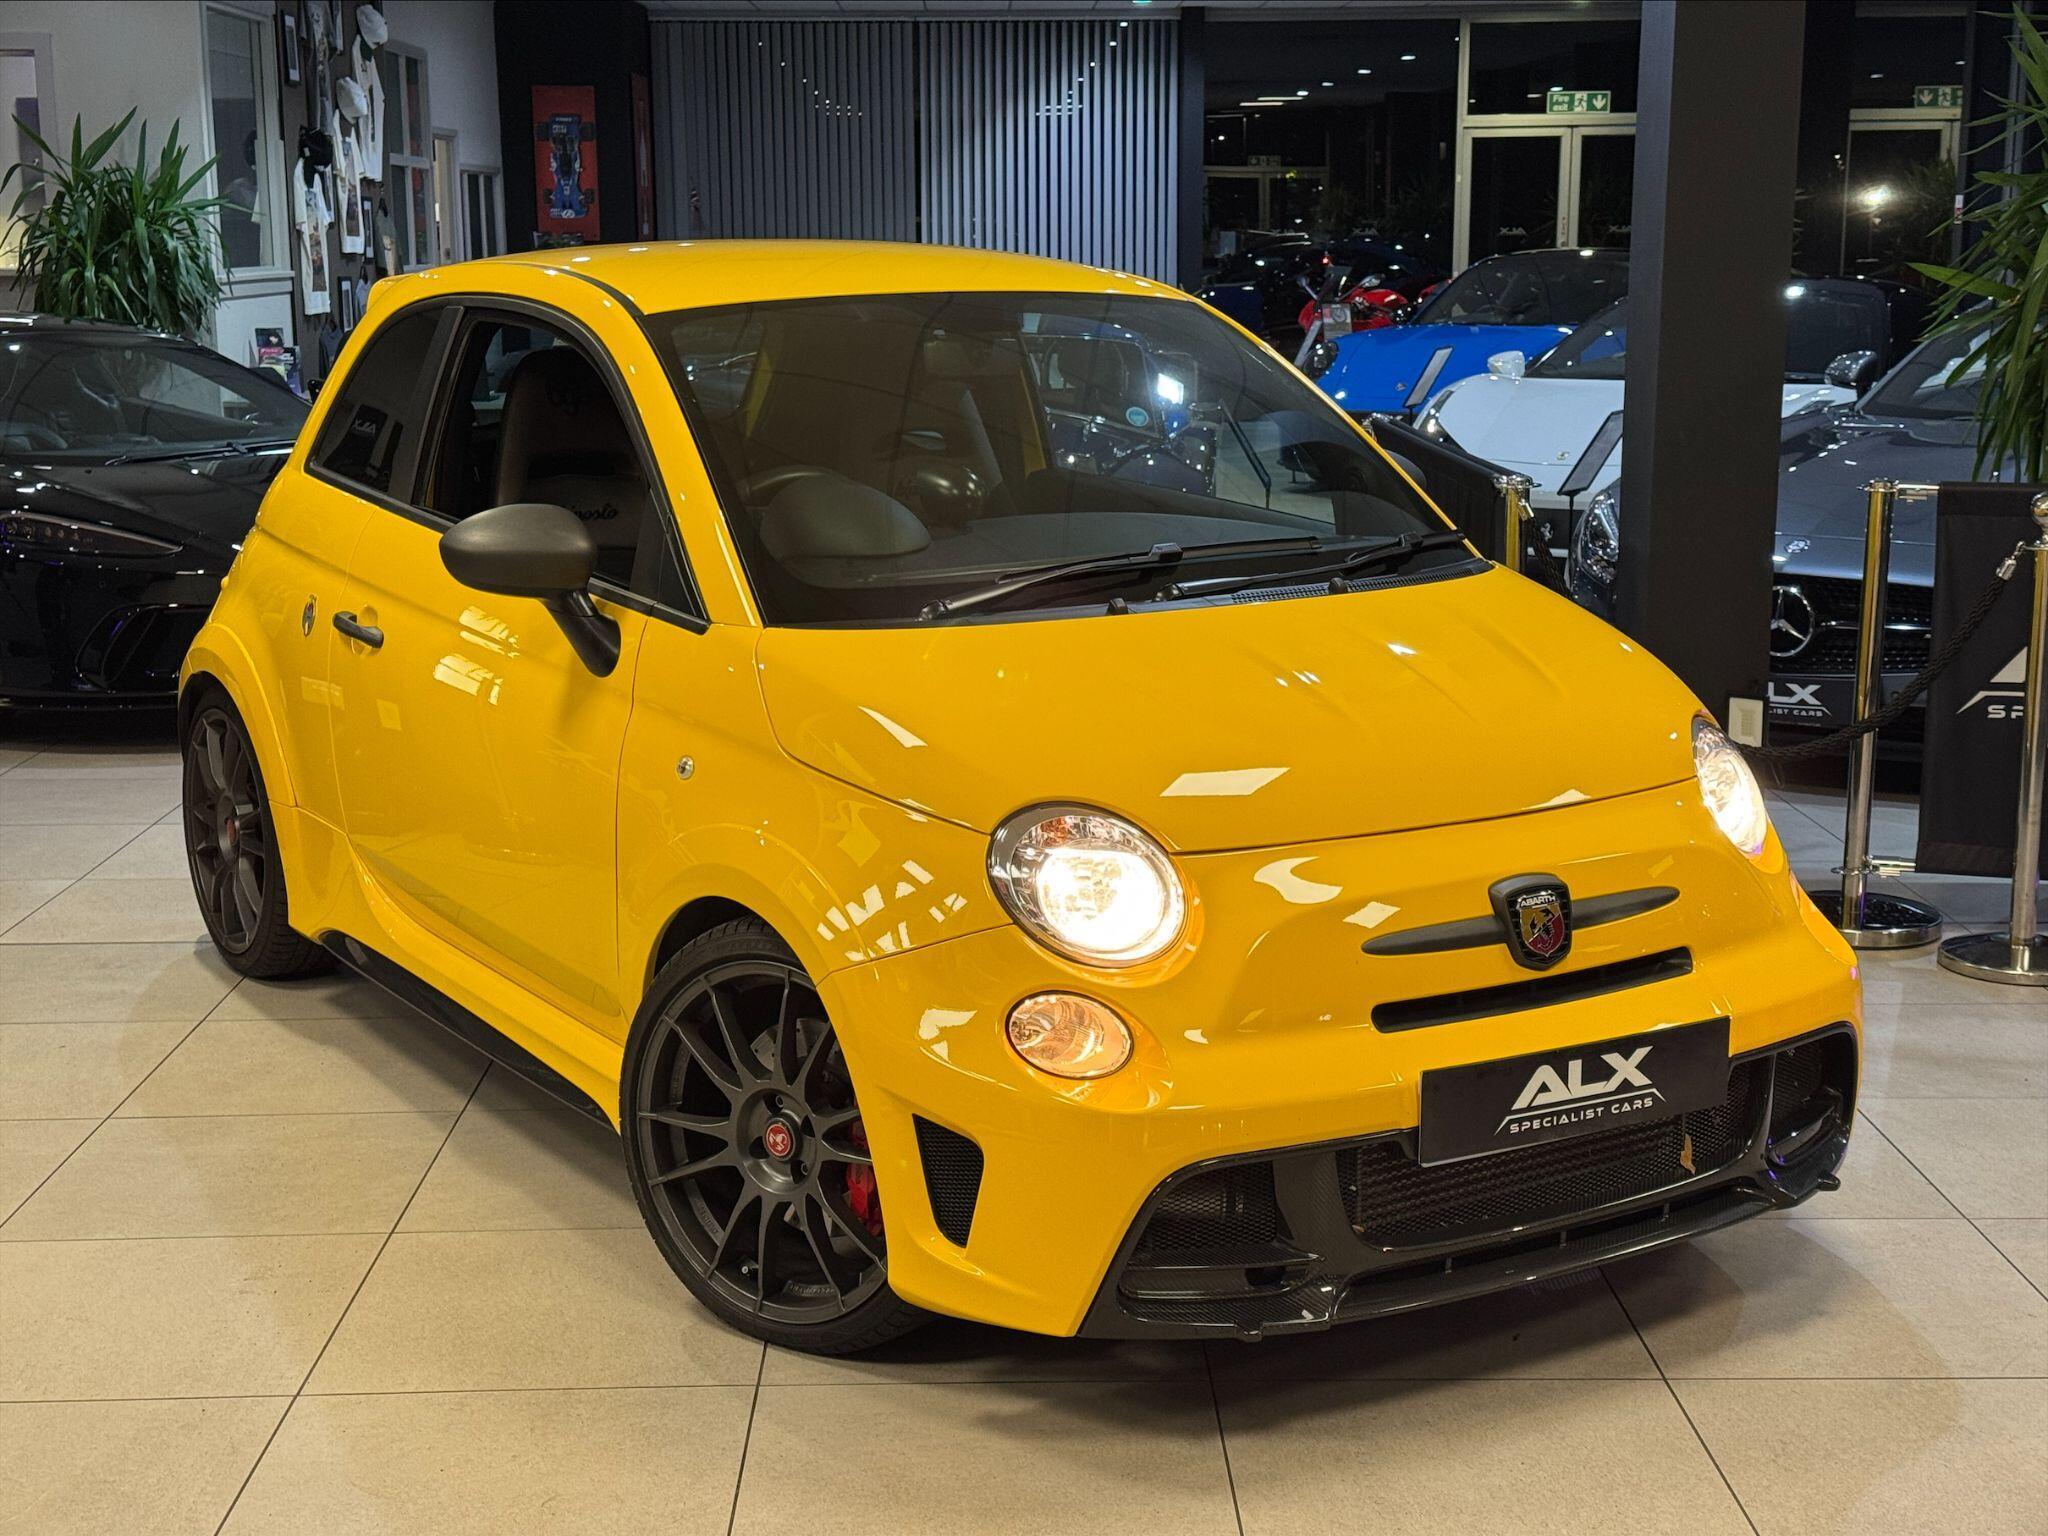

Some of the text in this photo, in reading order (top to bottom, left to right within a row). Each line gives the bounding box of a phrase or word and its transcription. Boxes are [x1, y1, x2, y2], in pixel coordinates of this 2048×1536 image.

[1553, 94, 1570, 103] Fire
[1767, 681, 1823, 706] LX
[1792, 708, 1824, 718] CARS
[1520, 894, 1557, 907] ABARTH
[1510, 1045, 1655, 1111] ALX
[1509, 1096, 1654, 1134] SPECIALIST CARS
